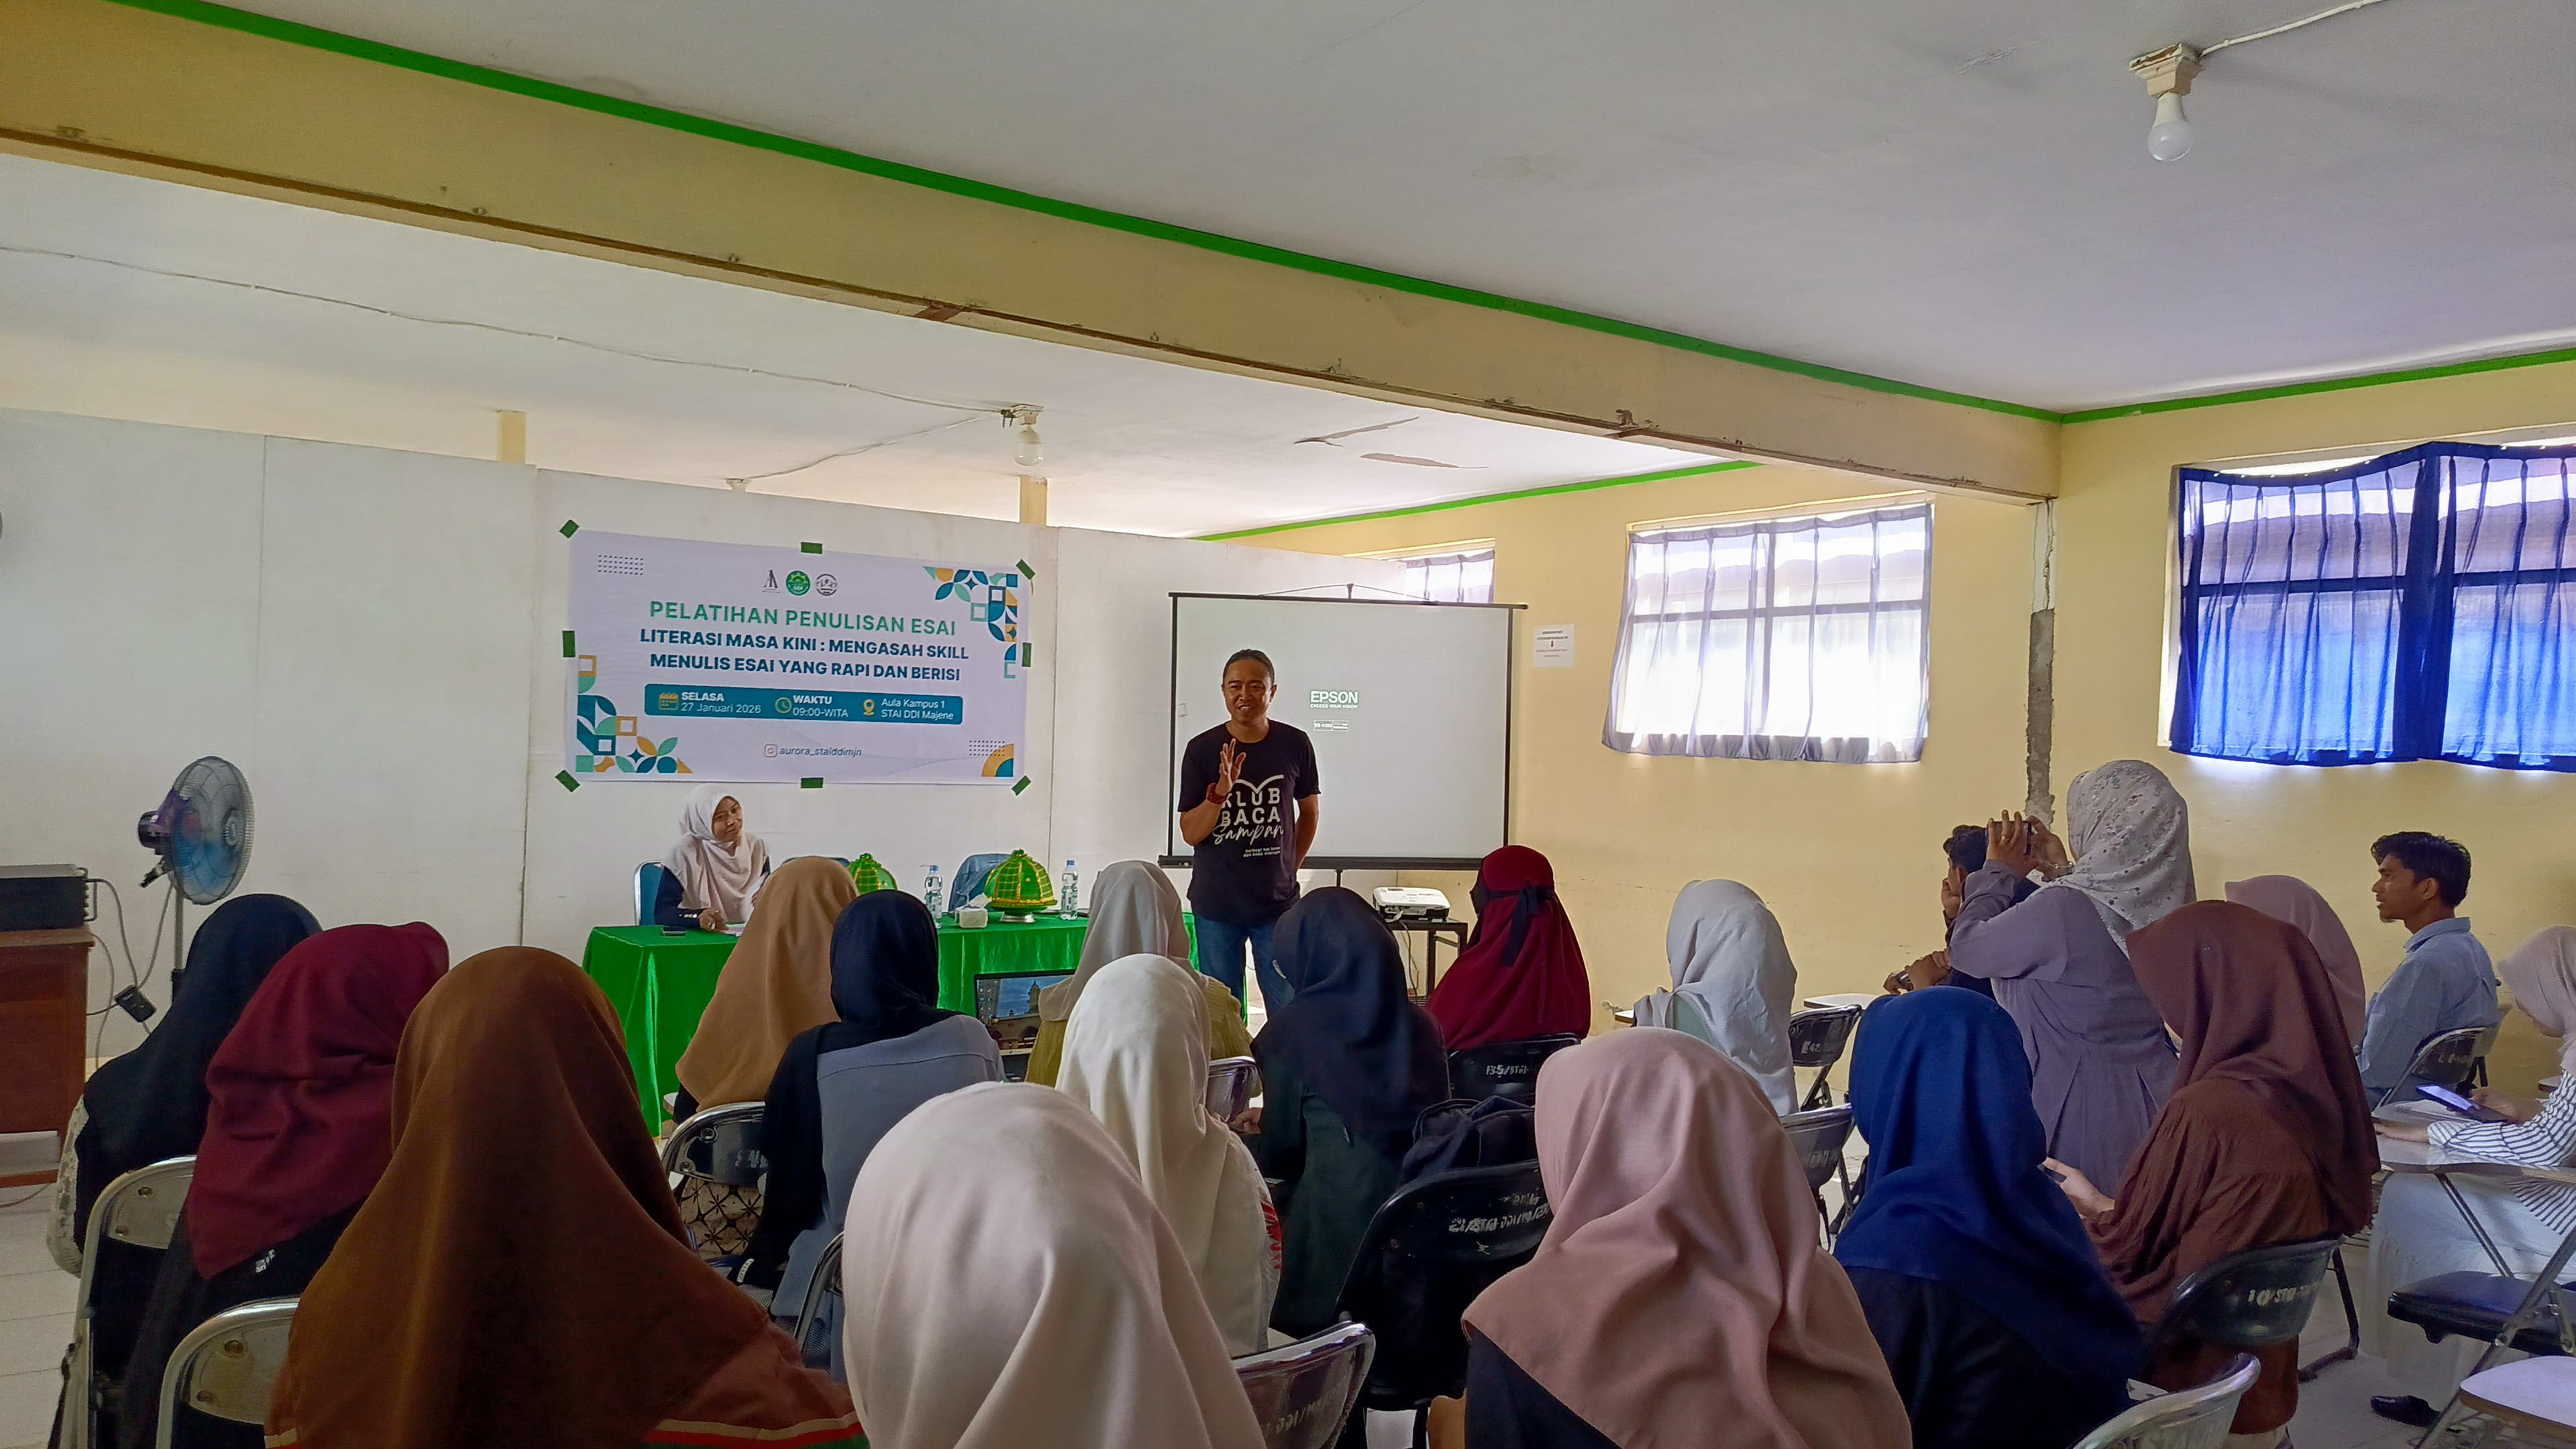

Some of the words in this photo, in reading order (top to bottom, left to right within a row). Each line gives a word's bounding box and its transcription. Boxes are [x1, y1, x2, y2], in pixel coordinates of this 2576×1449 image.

[650, 600, 778, 625] PELATIHAN
[786, 610, 904, 632] PENULISAN
[911, 618, 955, 635] ESAI
[640, 629, 722, 646] LITERASI
[726, 633, 779, 649] MASA
[783, 637, 816, 651] KINI
[828, 639, 923, 657] MENGASAH
[926, 645, 969, 659] SKILL
[650, 653, 731, 670] MENULIS
[735, 657, 774, 672] ESAI
[779, 659, 827, 675] YANG
[831, 662, 870, 677] RAPI
[873, 664, 908, 678] DAN
[911, 666, 961, 681] BERISI
[681, 692, 724, 702] SELASA
[793, 694, 833, 704] WAKTU
[881, 698, 901, 707] Aula
[904, 699, 939, 709] Kampus
[941, 700, 945, 708] 1
[1310, 690, 1358, 704] EPSON
[681, 702, 694, 712] 27
[696, 703, 733, 712] Januari
[735, 704, 762, 714] 2026
[881, 709, 902, 718] STAI
[904, 710, 920, 718] DDI
[922, 711, 954, 721] Majene
[1222, 806, 1281, 826] BACA
